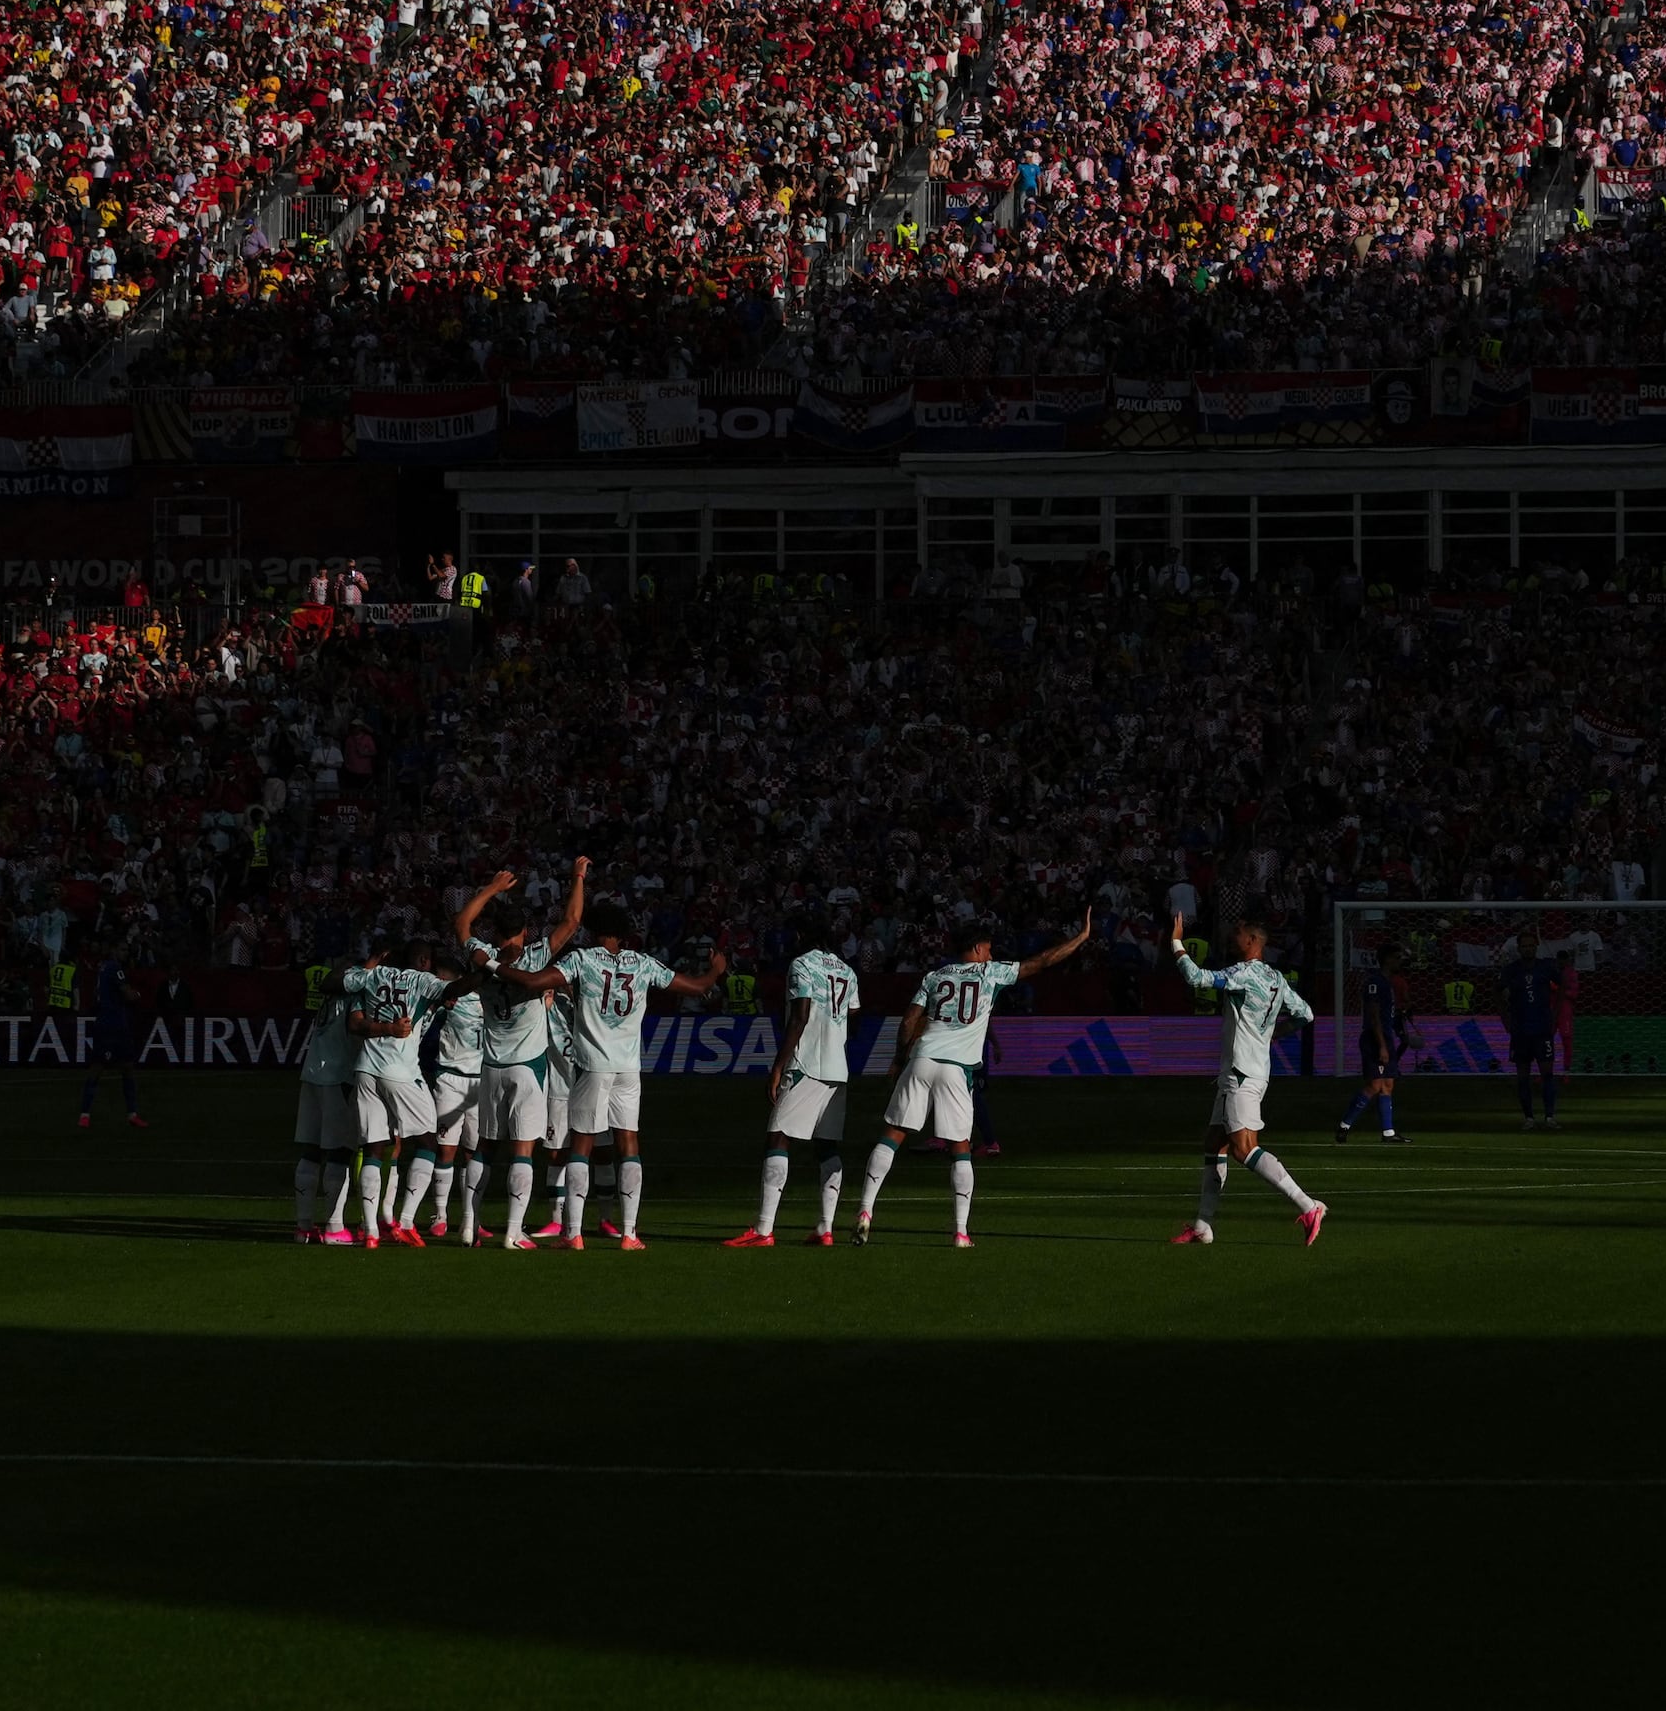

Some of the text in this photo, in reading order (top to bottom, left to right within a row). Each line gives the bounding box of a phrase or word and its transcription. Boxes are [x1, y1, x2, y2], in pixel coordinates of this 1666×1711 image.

[192, 415, 222, 431] KUP
[494, 984, 511, 1021] 3
[600, 969, 634, 1016] 13
[827, 975, 849, 1019] 17
[935, 980, 982, 1025] 20
[1261, 987, 1278, 1028] 7
[1526, 991, 1535, 1004] 3
[138, 1016, 314, 1065] AIRW
[641, 1017, 779, 1073] VISA
[1546, 1040, 1554, 1053] 3
